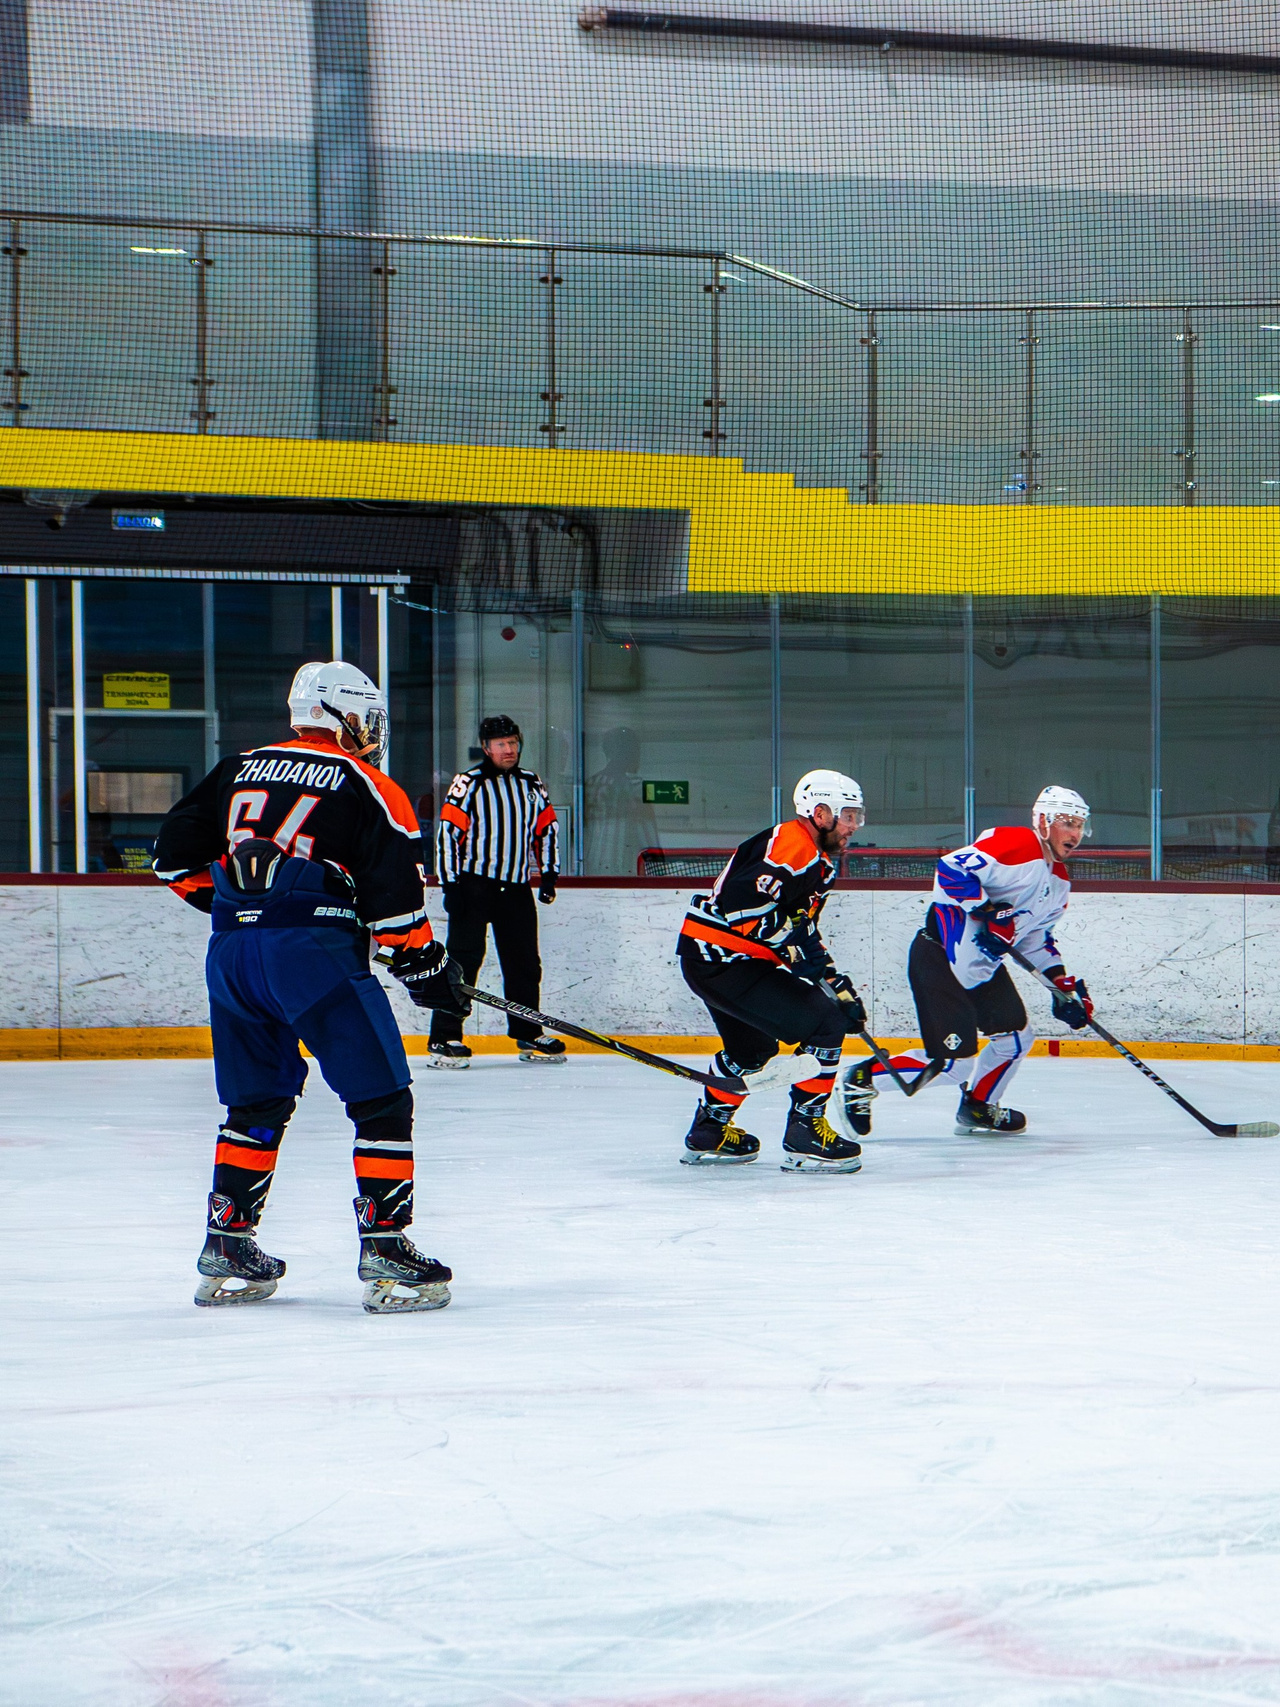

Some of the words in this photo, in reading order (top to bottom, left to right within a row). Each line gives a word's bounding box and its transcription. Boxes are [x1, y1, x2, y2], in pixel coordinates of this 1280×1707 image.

[340, 688, 364, 697] BAUER
[233, 759, 346, 791] ZHADANOV
[227, 790, 321, 861] 64
[953, 852, 988, 871] 47
[473, 991, 561, 1027] BAUER
